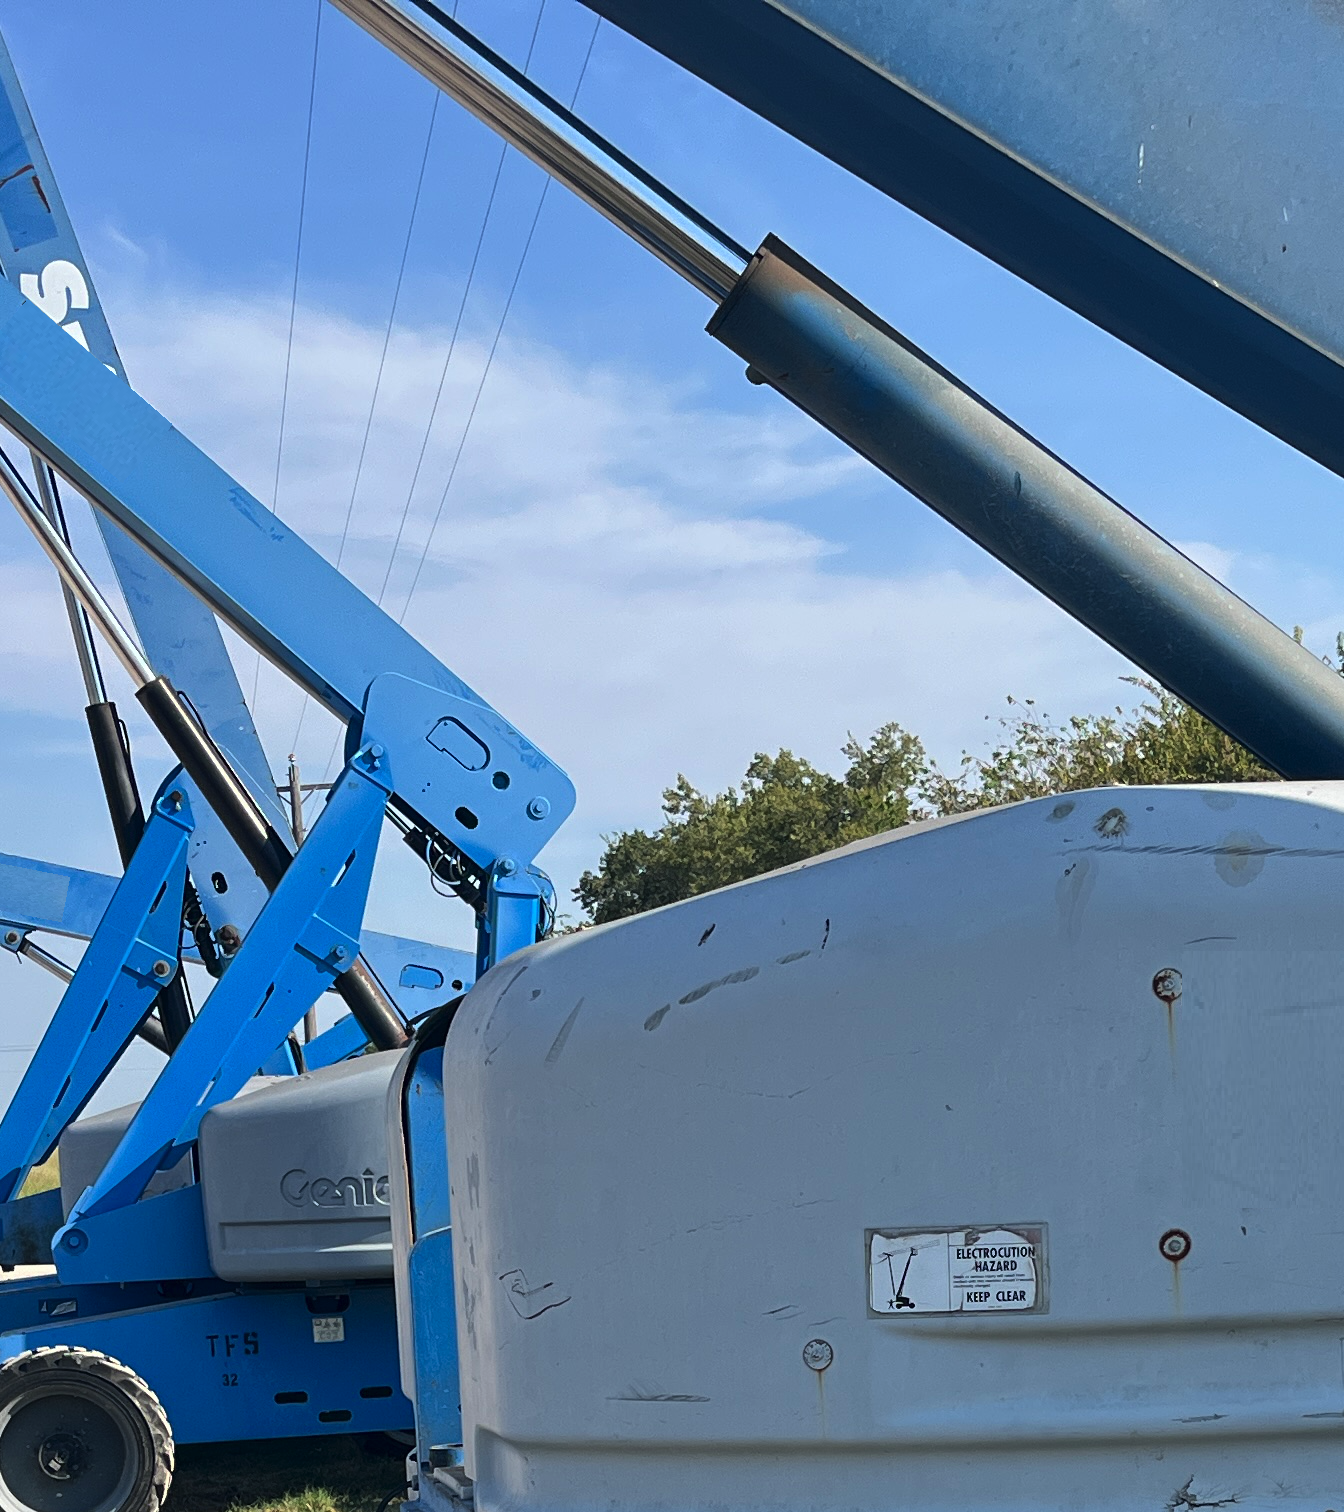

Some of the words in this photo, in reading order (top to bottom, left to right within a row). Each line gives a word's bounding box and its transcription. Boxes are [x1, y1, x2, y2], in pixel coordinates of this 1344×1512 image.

[19, 259, 118, 376] S-
[956, 1246, 1035, 1261] ELECTROCUTION
[975, 1260, 1017, 1273] HAZARD
[966, 1291, 991, 1303] KEEP
[995, 1290, 1027, 1302] CLEAR
[205, 1331, 260, 1358] TFS
[222, 1373, 239, 1387] 32
